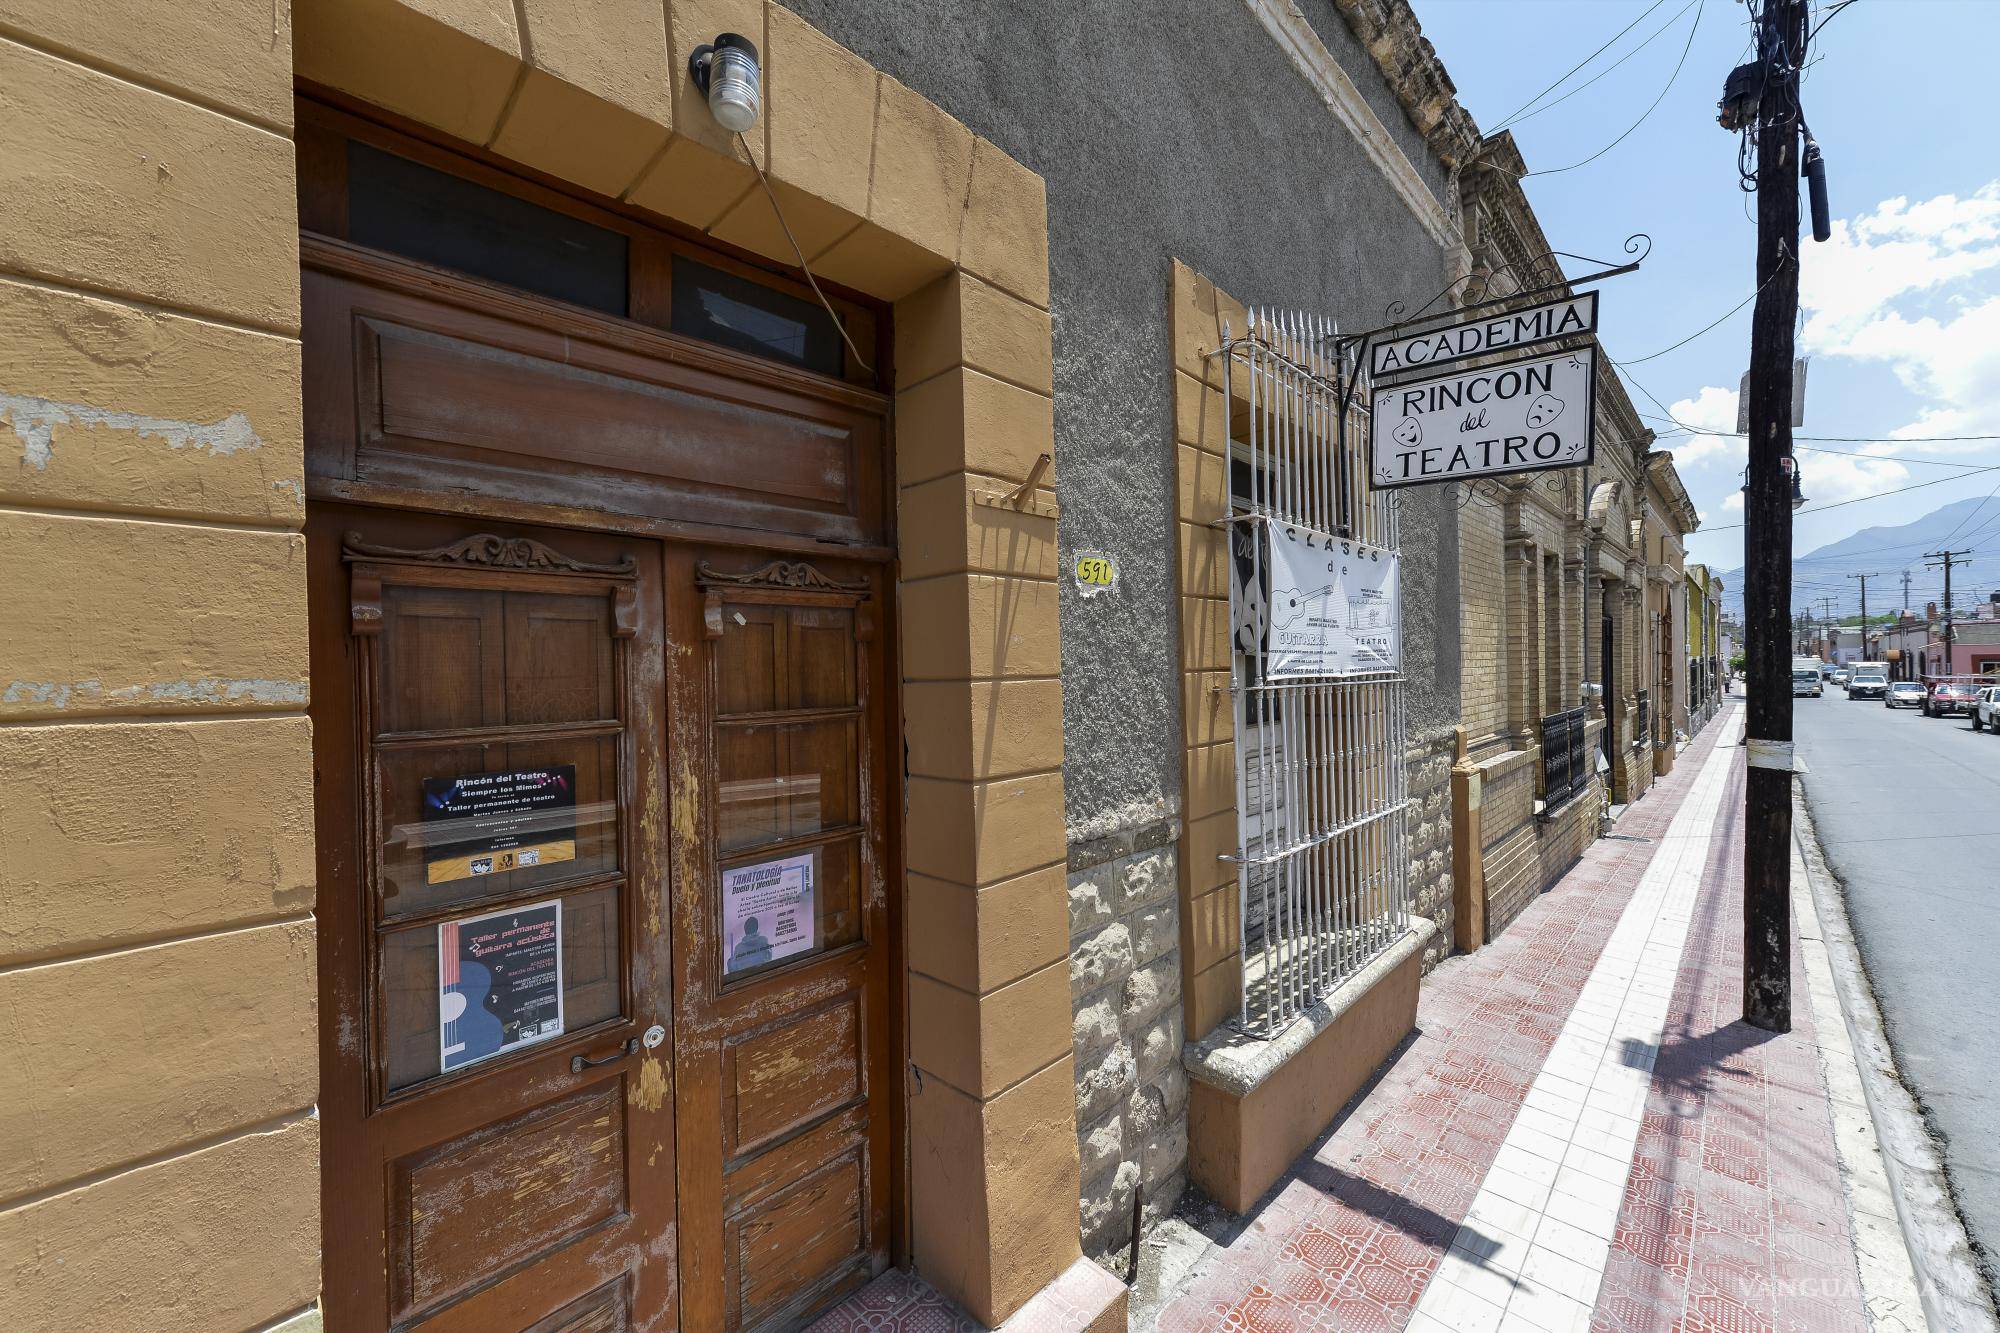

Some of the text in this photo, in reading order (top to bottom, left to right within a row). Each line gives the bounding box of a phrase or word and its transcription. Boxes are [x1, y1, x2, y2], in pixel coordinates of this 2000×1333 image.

[1380, 303, 1586, 371] ACADEMIA
[1402, 363, 1553, 417] RINCON
[1459, 408, 1490, 433] del
[1396, 431, 1561, 478] TEATRO
[1285, 527, 1378, 563] CLASES
[1082, 561, 1107, 581] 591
[1327, 560, 1348, 575] de
[1278, 631, 1329, 647] GUITARRA
[455, 772, 548, 788] Rincón del Teatro
[461, 788, 497, 797] Siempre
[447, 804, 472, 812] Taller
[473, 799, 519, 809] permanente
[732, 864, 782, 886] TANATOLOGÍA
[732, 876, 781, 895] Duelo y plenitud
[471, 920, 555, 944] Taller permanente
[540, 927, 551, 935] de
[475, 932, 555, 957] guitarra acústica
